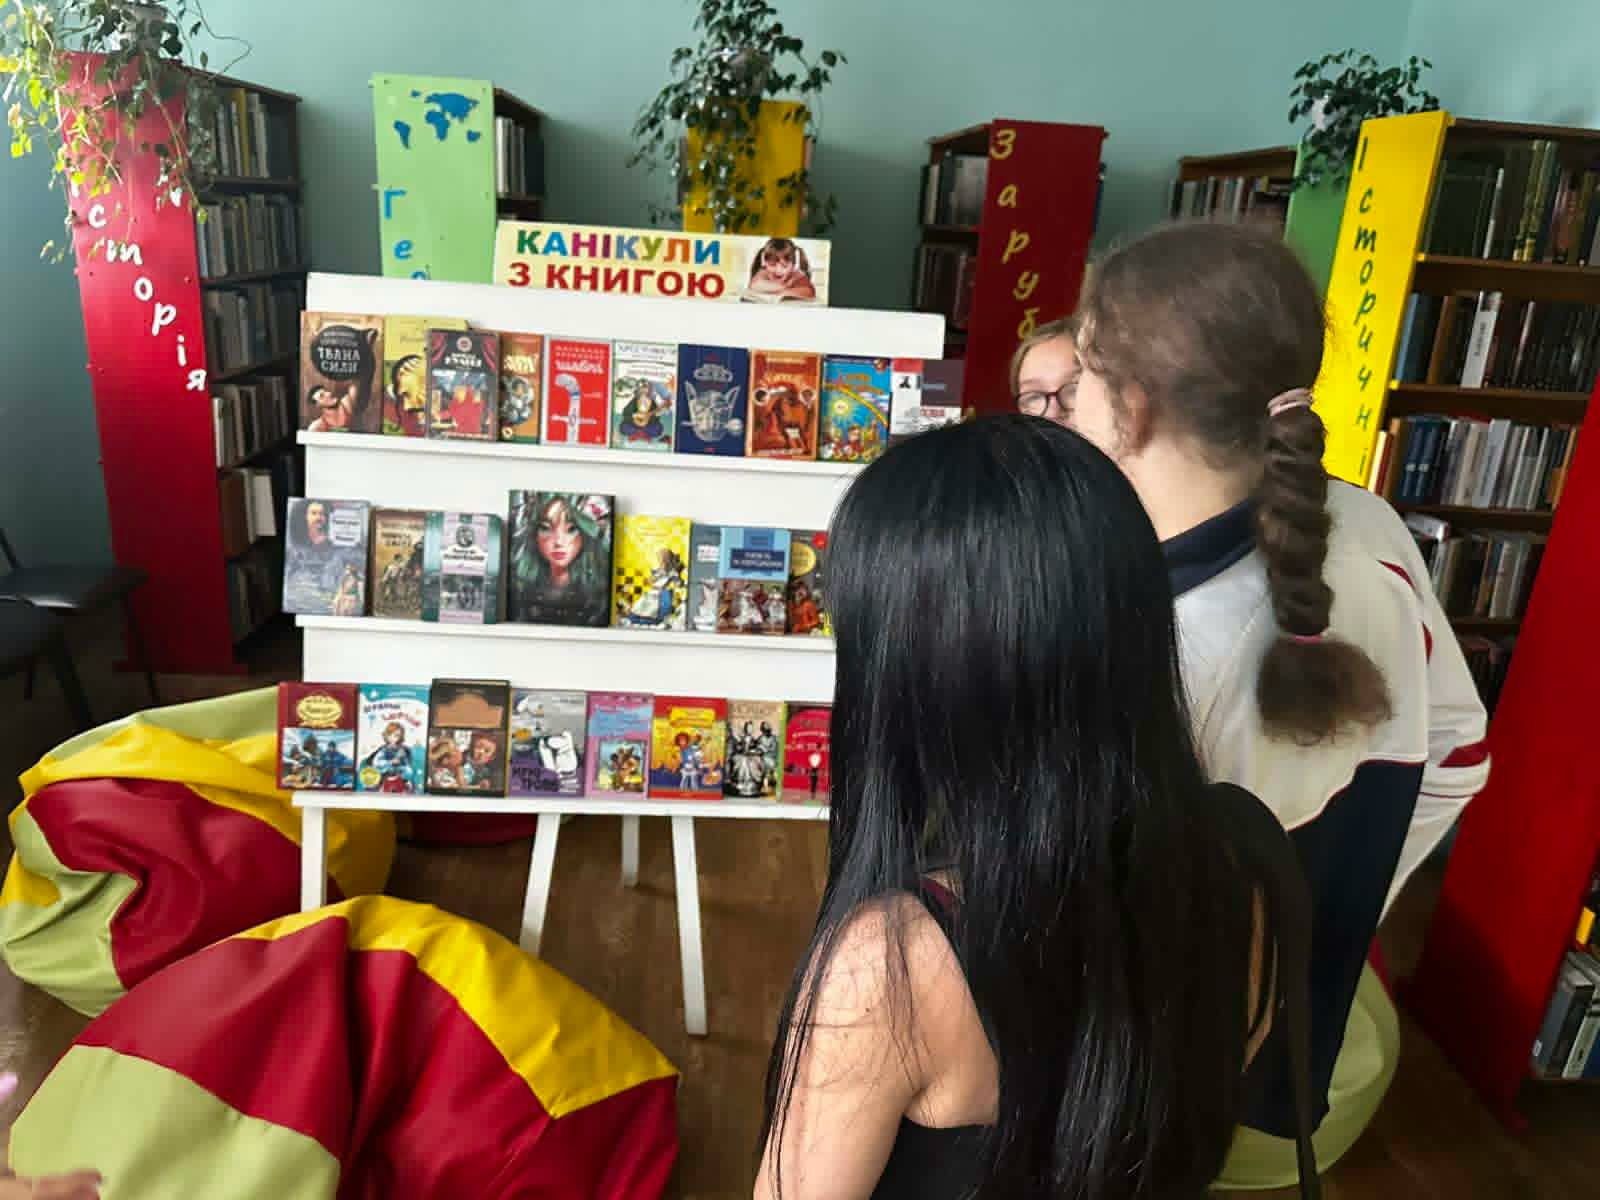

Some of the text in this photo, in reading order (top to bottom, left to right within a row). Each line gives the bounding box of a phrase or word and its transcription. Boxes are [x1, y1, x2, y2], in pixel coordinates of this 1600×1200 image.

[516, 229, 721, 265] КАНІКУЛИ
[508, 262, 726, 298] З КНИГОЮ
[1354, 136, 1377, 477] Історичні
